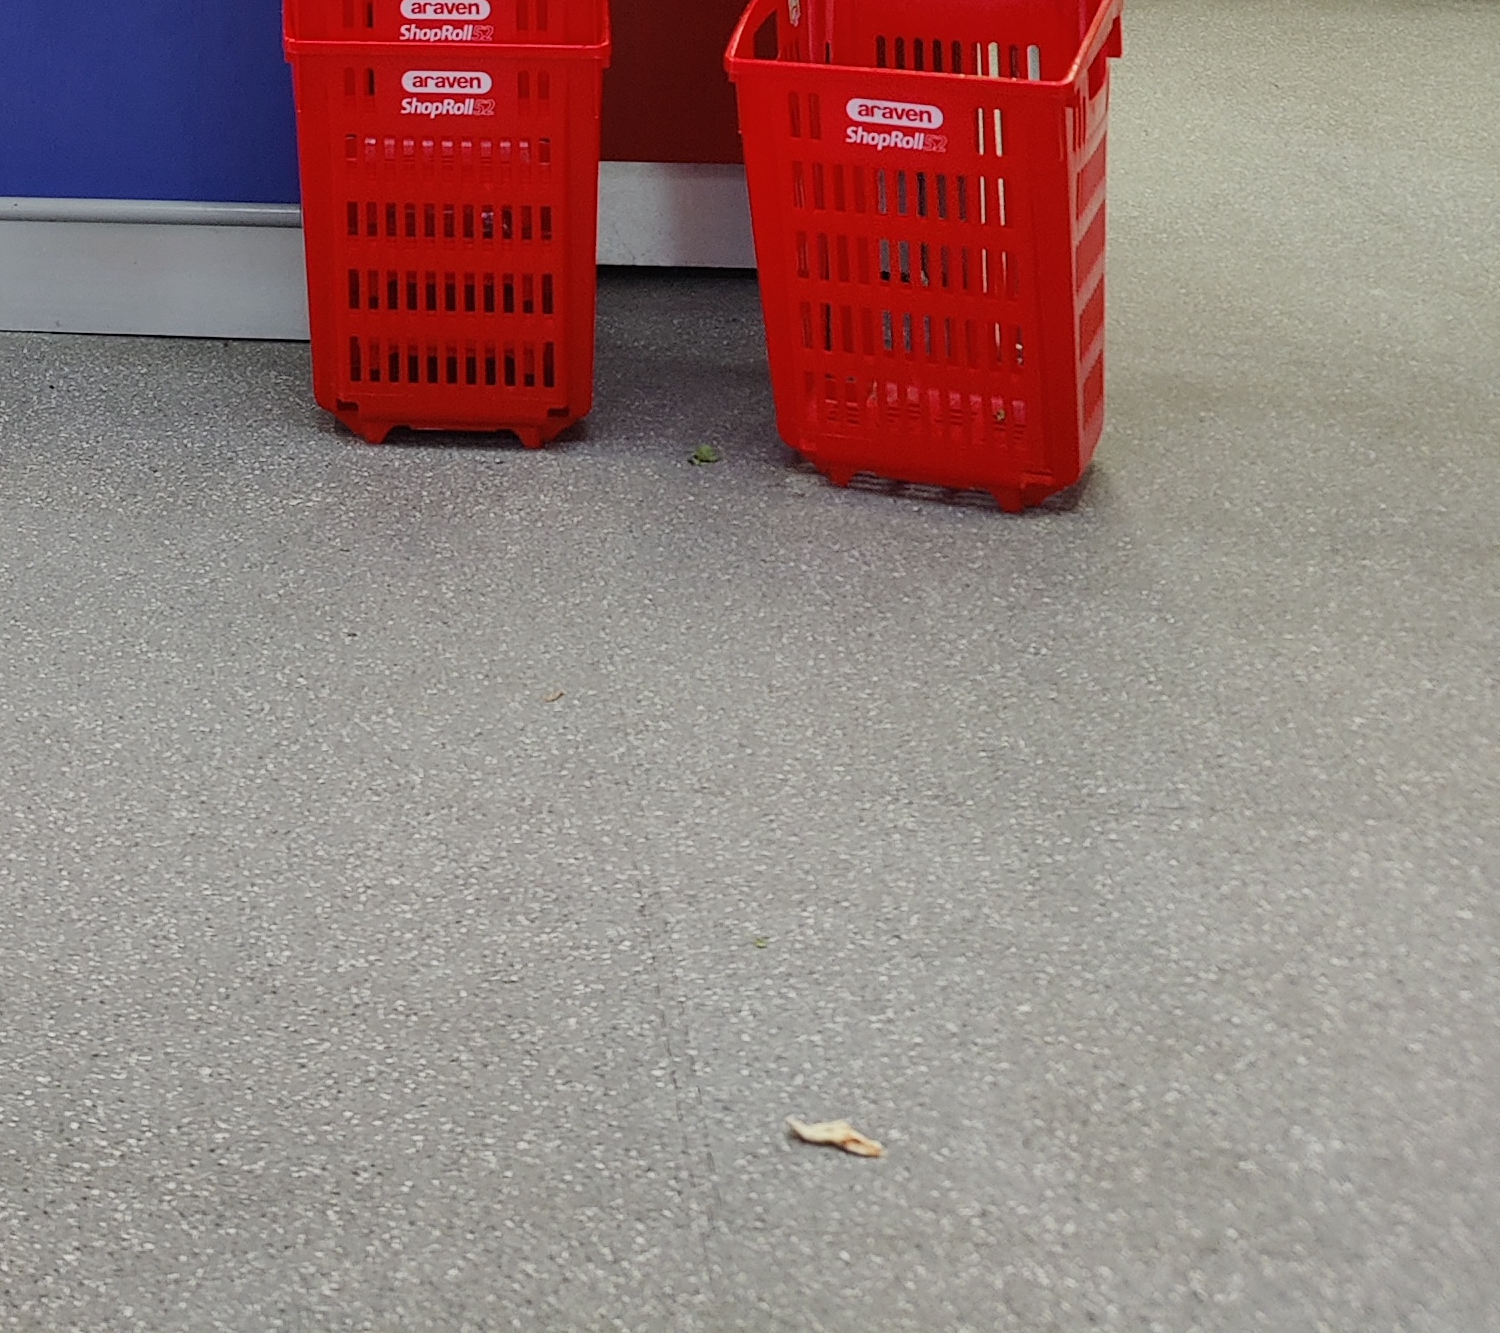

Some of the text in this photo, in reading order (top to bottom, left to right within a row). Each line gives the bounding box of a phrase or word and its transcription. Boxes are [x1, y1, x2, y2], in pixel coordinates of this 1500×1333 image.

[411, 1, 480, 16] araven
[412, 74, 482, 90] araven
[857, 100, 933, 125] araven
